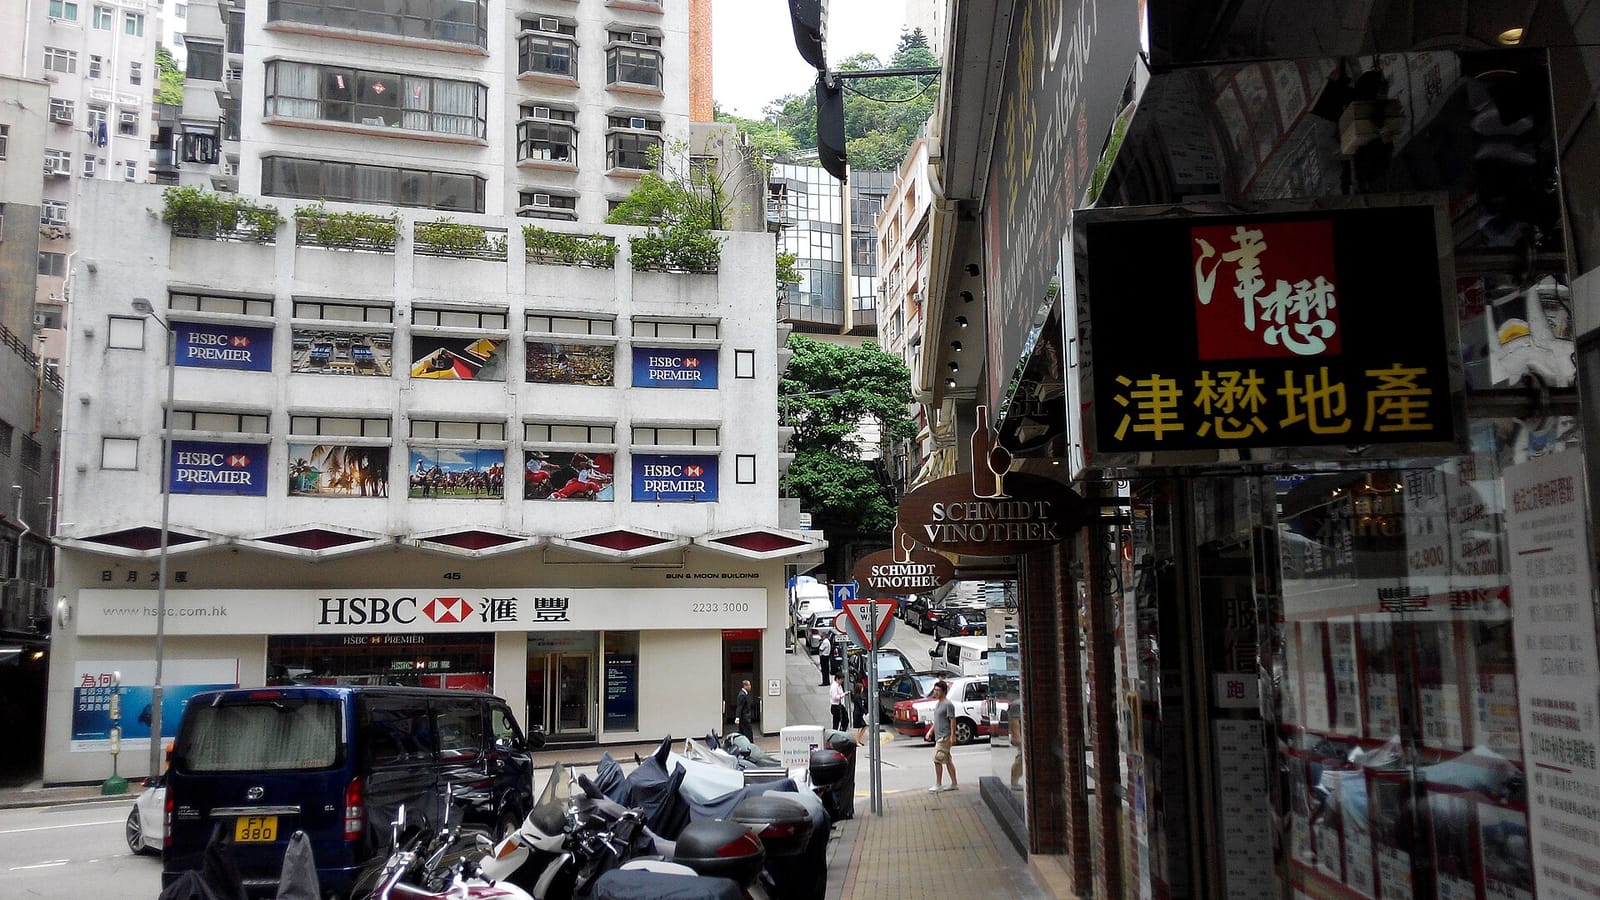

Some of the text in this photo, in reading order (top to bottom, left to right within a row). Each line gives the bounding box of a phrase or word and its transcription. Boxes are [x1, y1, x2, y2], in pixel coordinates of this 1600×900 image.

[1028, 113, 1055, 250] ESTATE
[187, 332, 228, 346] HSBC
[187, 347, 251, 362] PREMIER
[649, 357, 681, 367] HSBC
[649, 369, 702, 381] PREMIER
[1112, 363, 1434, 441] 津懋地產
[177, 451, 224, 466] HSBC
[176, 469, 251, 485] PREMIER
[644, 464, 682, 477] HSBC
[644, 480, 705, 493] PREMIER
[932, 501, 1051, 522] SCHMIDT
[923, 522, 1061, 543] VINOTHEK
[443, 572, 461, 580] 45
[871, 564, 935, 576] SCHMIDT
[867, 576, 941, 588] VINOTHEK
[103, 606, 227, 616] wwwhsc.com.hk
[318, 597, 417, 625] HSBC
[692, 602, 749, 613] 2233 3000
[343, 634, 425, 645] HSBC PREMIER
[81, 673, 113, 688] 為何
[249, 817, 268, 828] FT
[241, 829, 271, 840] 380
